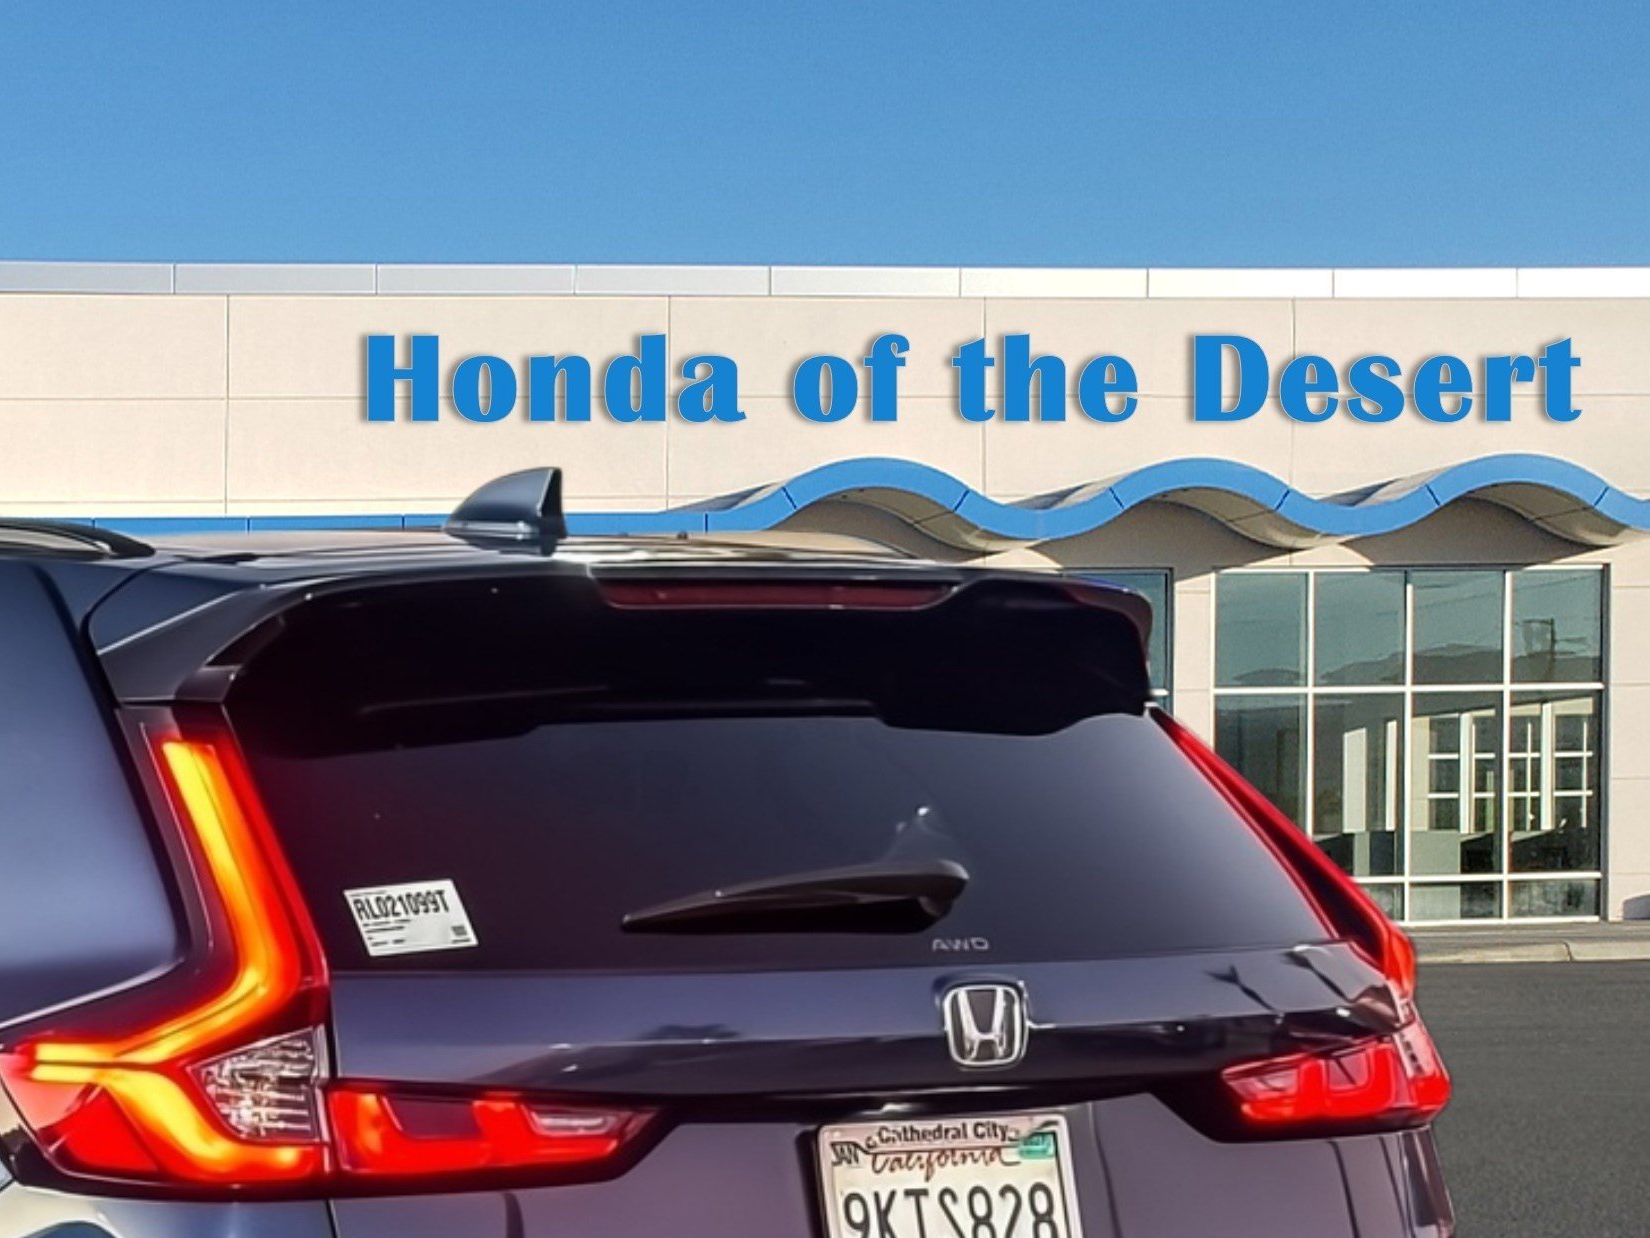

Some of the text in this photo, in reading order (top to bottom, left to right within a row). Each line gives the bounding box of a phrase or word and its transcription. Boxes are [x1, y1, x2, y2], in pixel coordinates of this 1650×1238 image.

[366, 334, 1581, 423] Honda of the Desert
[353, 889, 449, 921] RL021099T
[878, 1121, 1009, 1144] Cathedral City
[871, 1148, 1021, 1182] California
